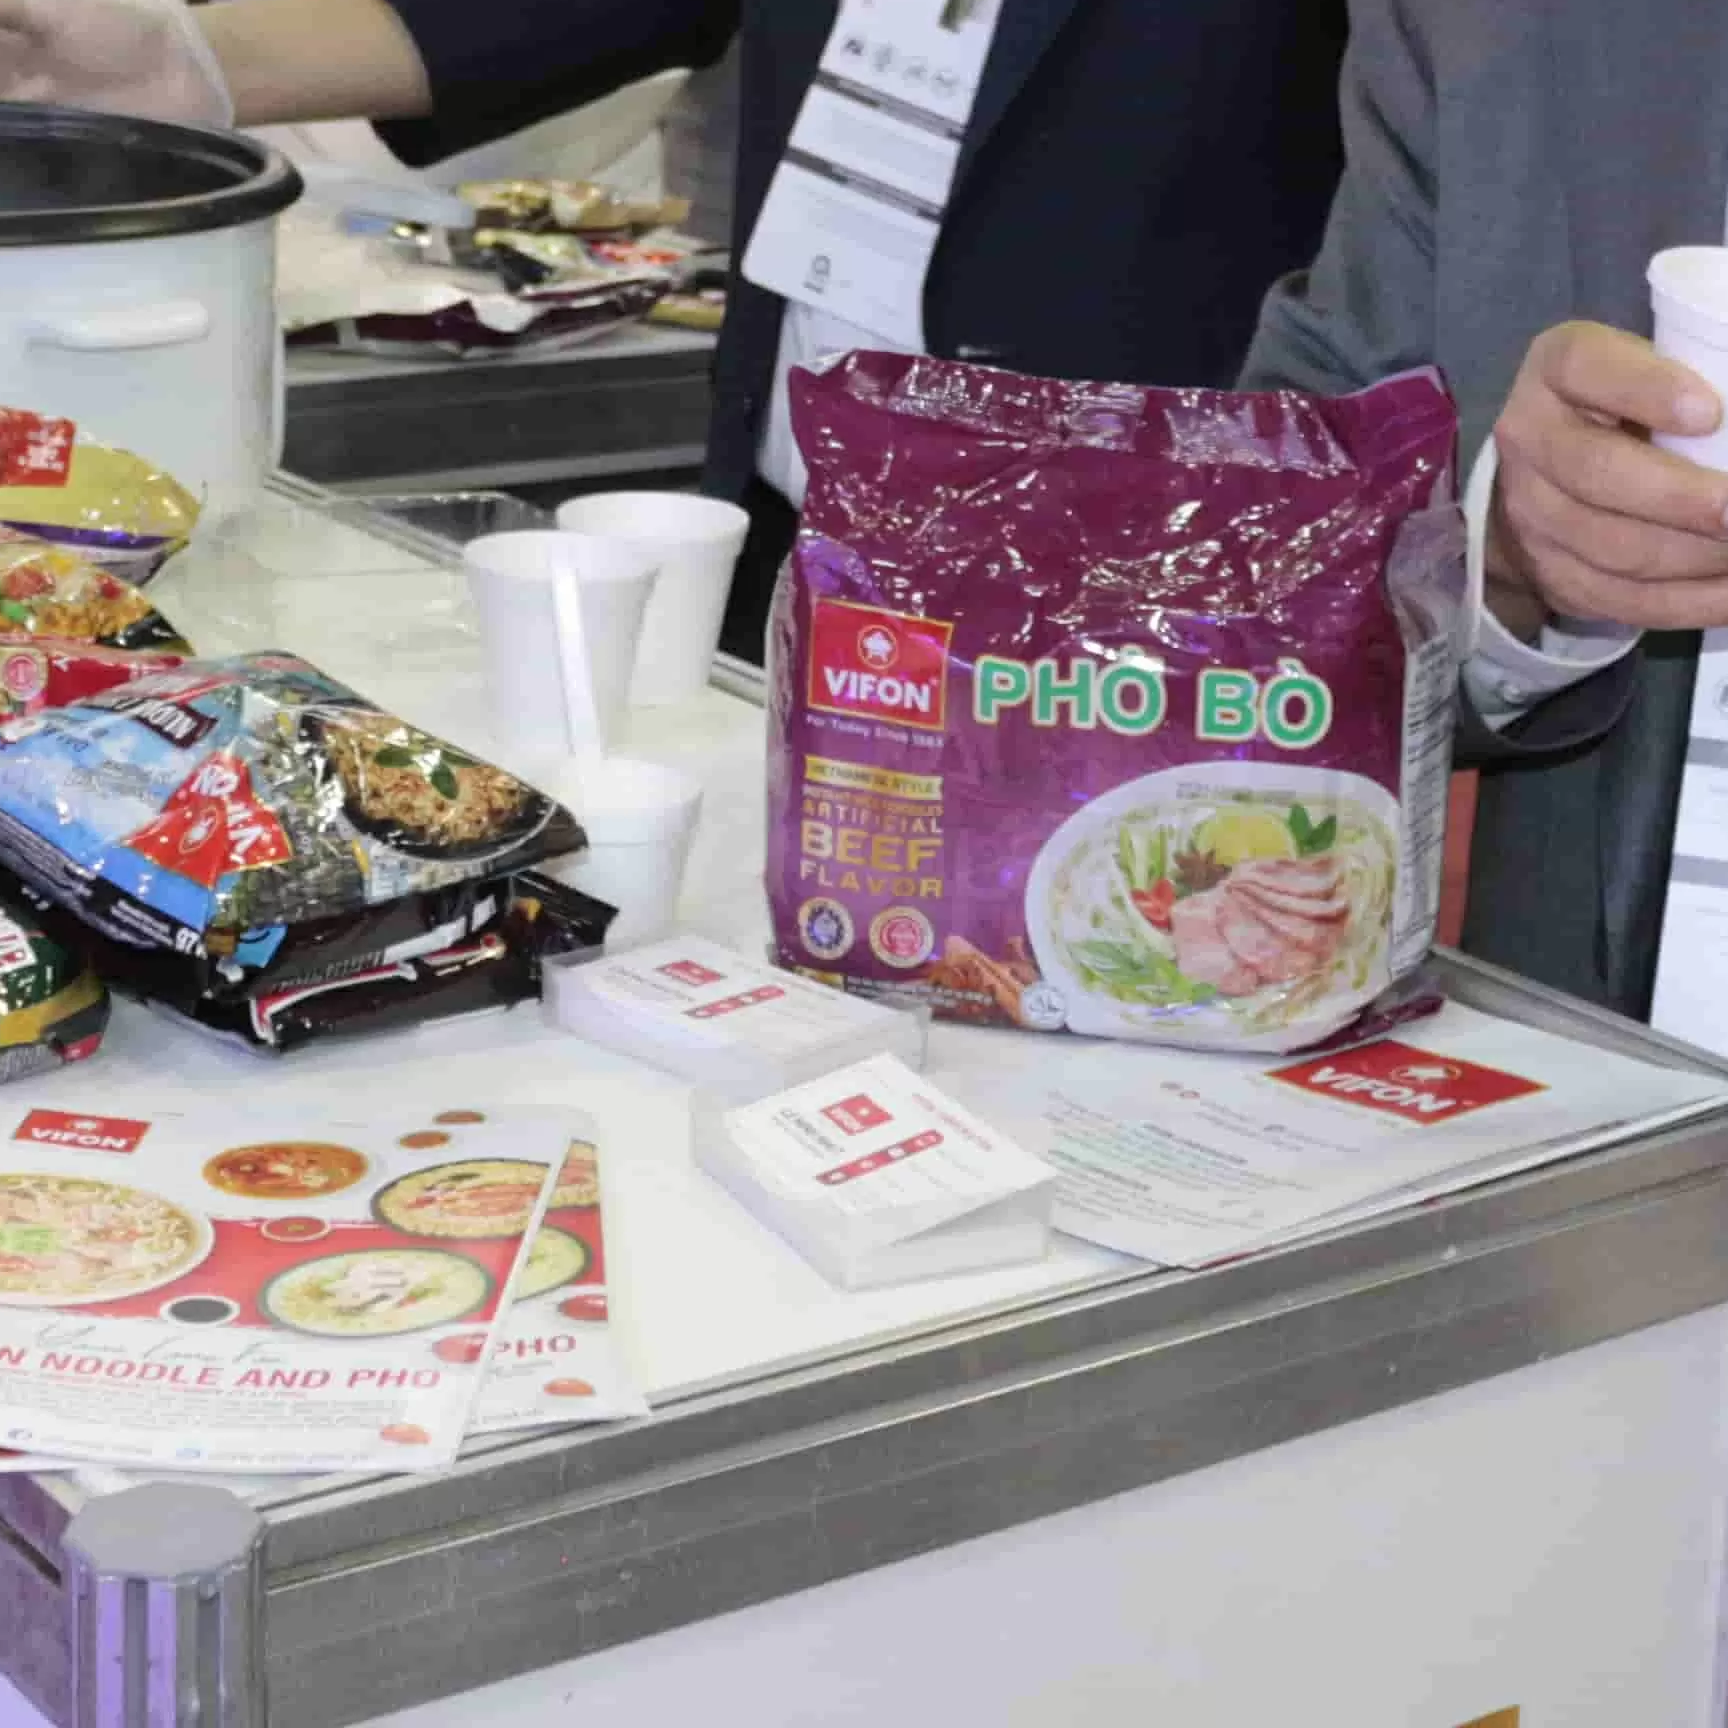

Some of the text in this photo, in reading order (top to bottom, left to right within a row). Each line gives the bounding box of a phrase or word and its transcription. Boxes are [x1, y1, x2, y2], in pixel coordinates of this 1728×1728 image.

[822, 665, 932, 713] VIFON
[800, 819, 944, 872] BEEF
[799, 858, 943, 900] FLAVOR
[1307, 1066, 1456, 1113] VIFON
[29, 1126, 128, 1150] VIFON
[39, 1350, 226, 1388] NOODLE
[235, 1367, 332, 1390] AND
[346, 1368, 441, 1390] PHO
